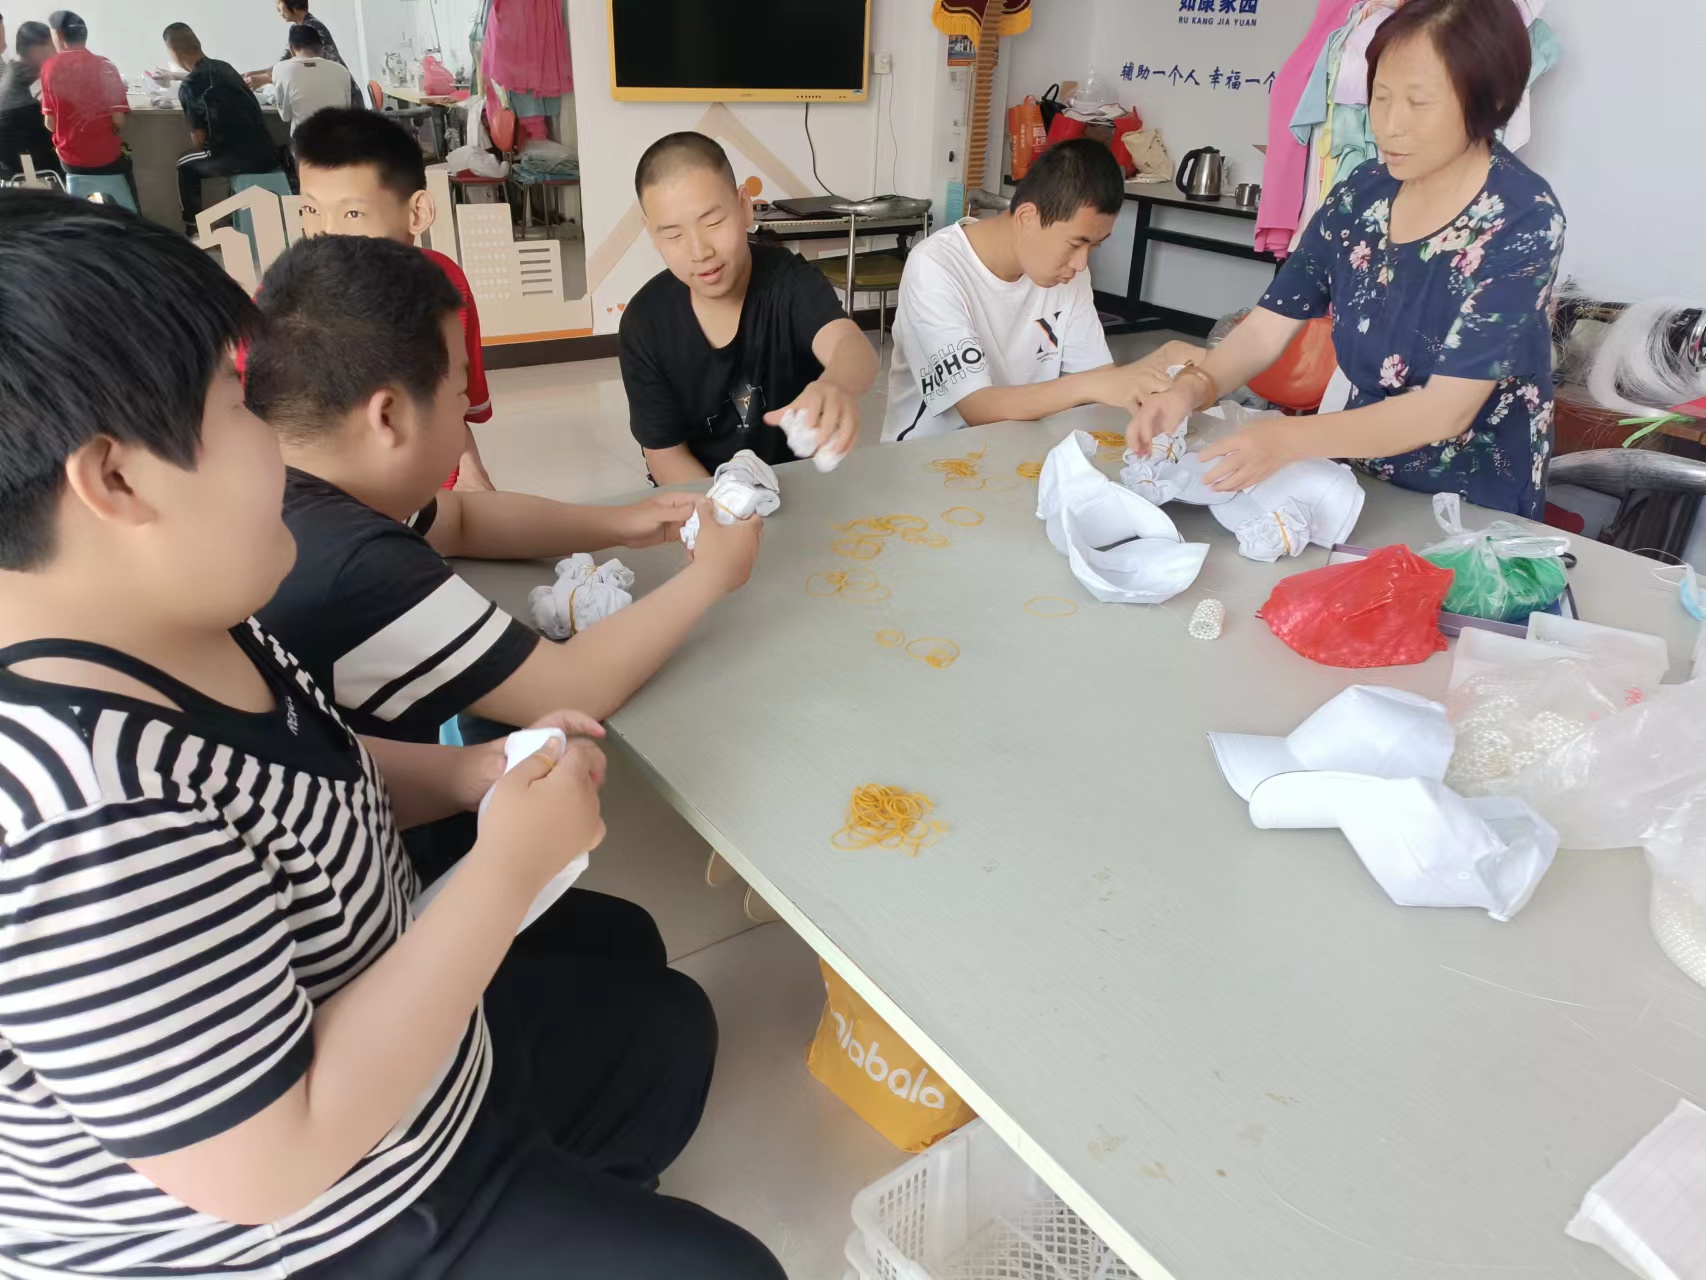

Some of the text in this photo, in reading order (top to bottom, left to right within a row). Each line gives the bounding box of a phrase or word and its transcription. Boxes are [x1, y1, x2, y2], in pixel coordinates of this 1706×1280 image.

[1178, 16, 1257, 27] RU KANG JIA YUAN
[1120, 62, 1200, 87] 辅助一个人
